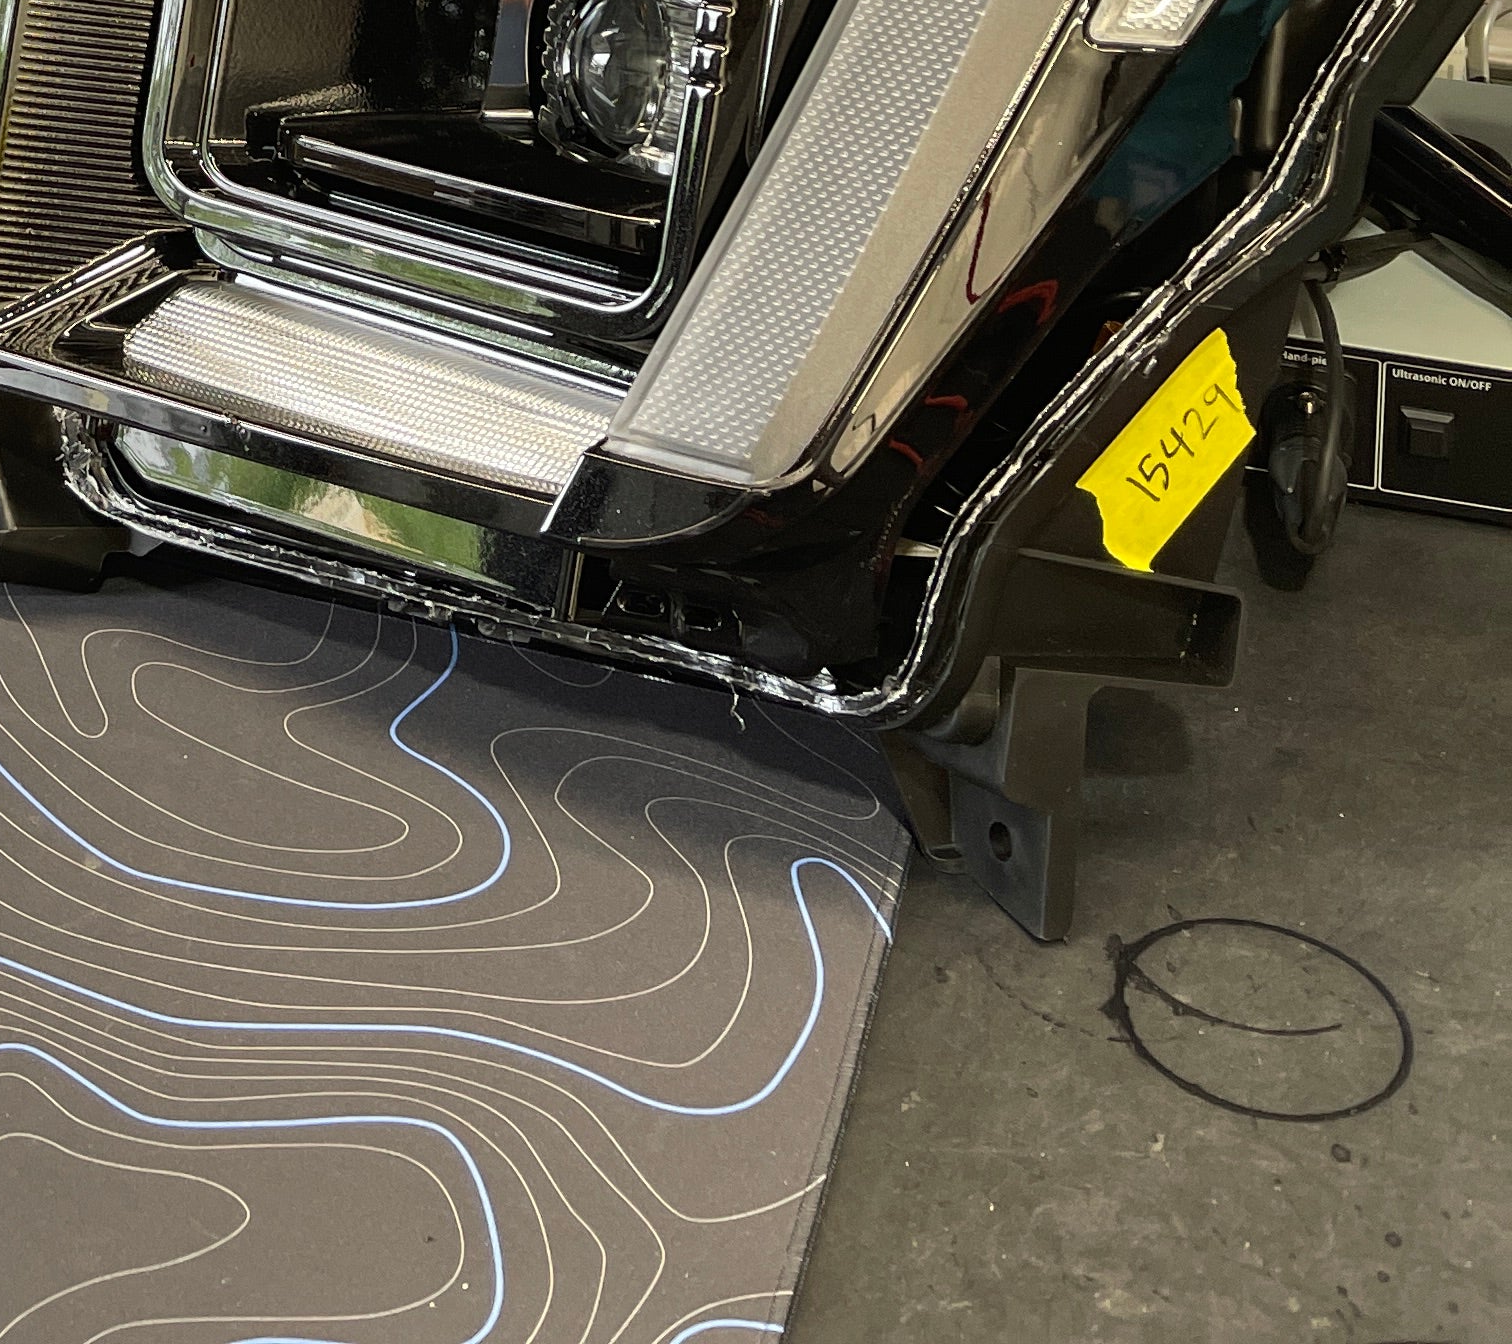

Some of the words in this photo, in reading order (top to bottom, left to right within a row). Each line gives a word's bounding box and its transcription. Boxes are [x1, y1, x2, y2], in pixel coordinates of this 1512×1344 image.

[1391, 368, 1448, 386] Ultrasonic
[1449, 376, 1492, 391] ON/OFF
[1125, 382, 1243, 503] 15429
